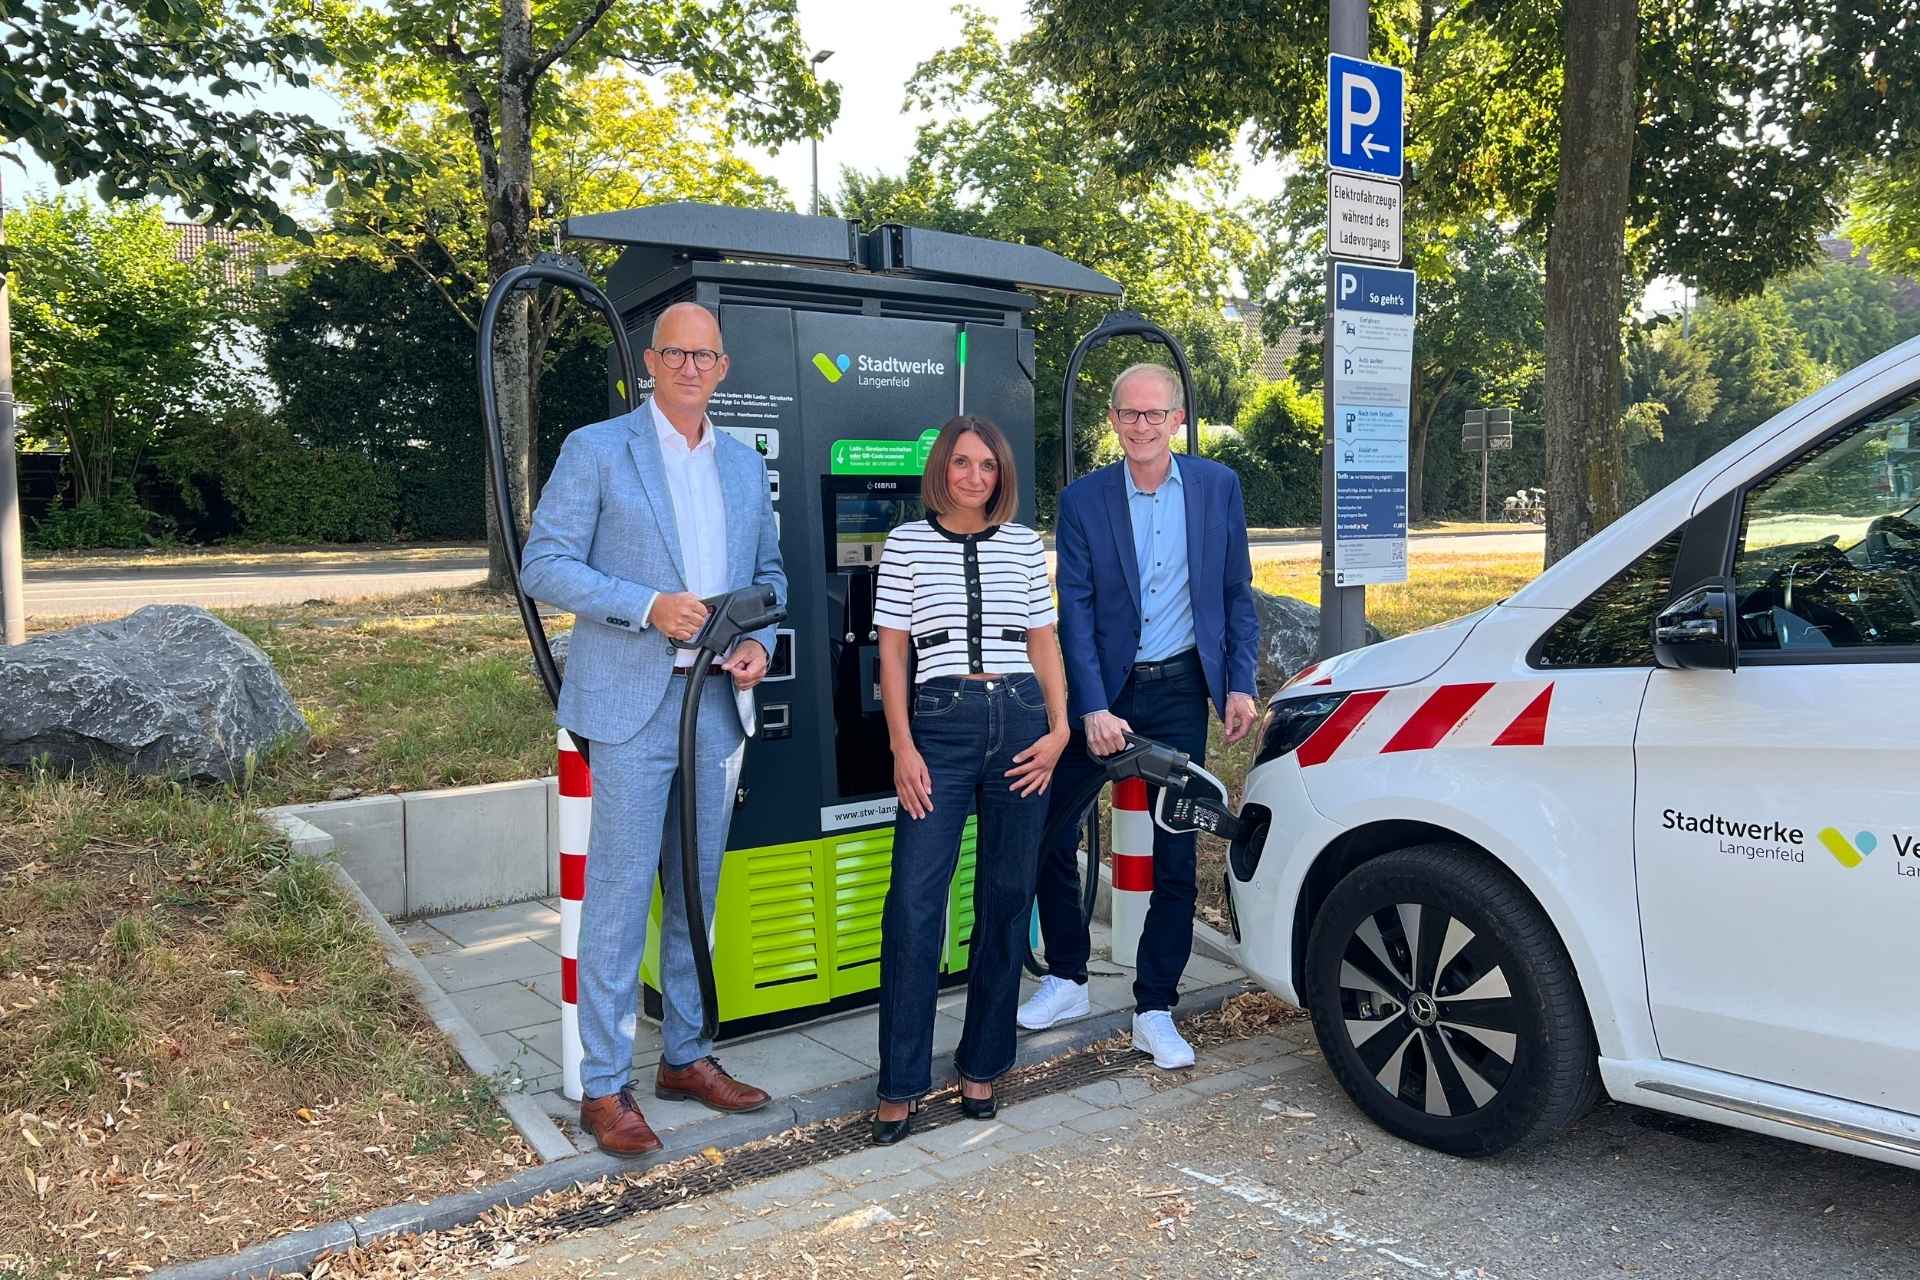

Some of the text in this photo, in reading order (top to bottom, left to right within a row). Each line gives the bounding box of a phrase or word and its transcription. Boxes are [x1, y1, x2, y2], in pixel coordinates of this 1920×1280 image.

[1342, 71, 1380, 155] P
[1334, 185, 1397, 209] Elektrofahrzeuge
[1342, 209, 1389, 227] während des
[1340, 231, 1391, 252] Ladevorgangs
[1341, 273, 1357, 301] P
[1369, 292, 1405, 307] So geht's
[858, 354, 945, 375] Stadtwerke
[858, 375, 910, 388] Langenfeld
[1662, 808, 1804, 845] Stadtwerke
[1719, 839, 1804, 863] Langenfeld
